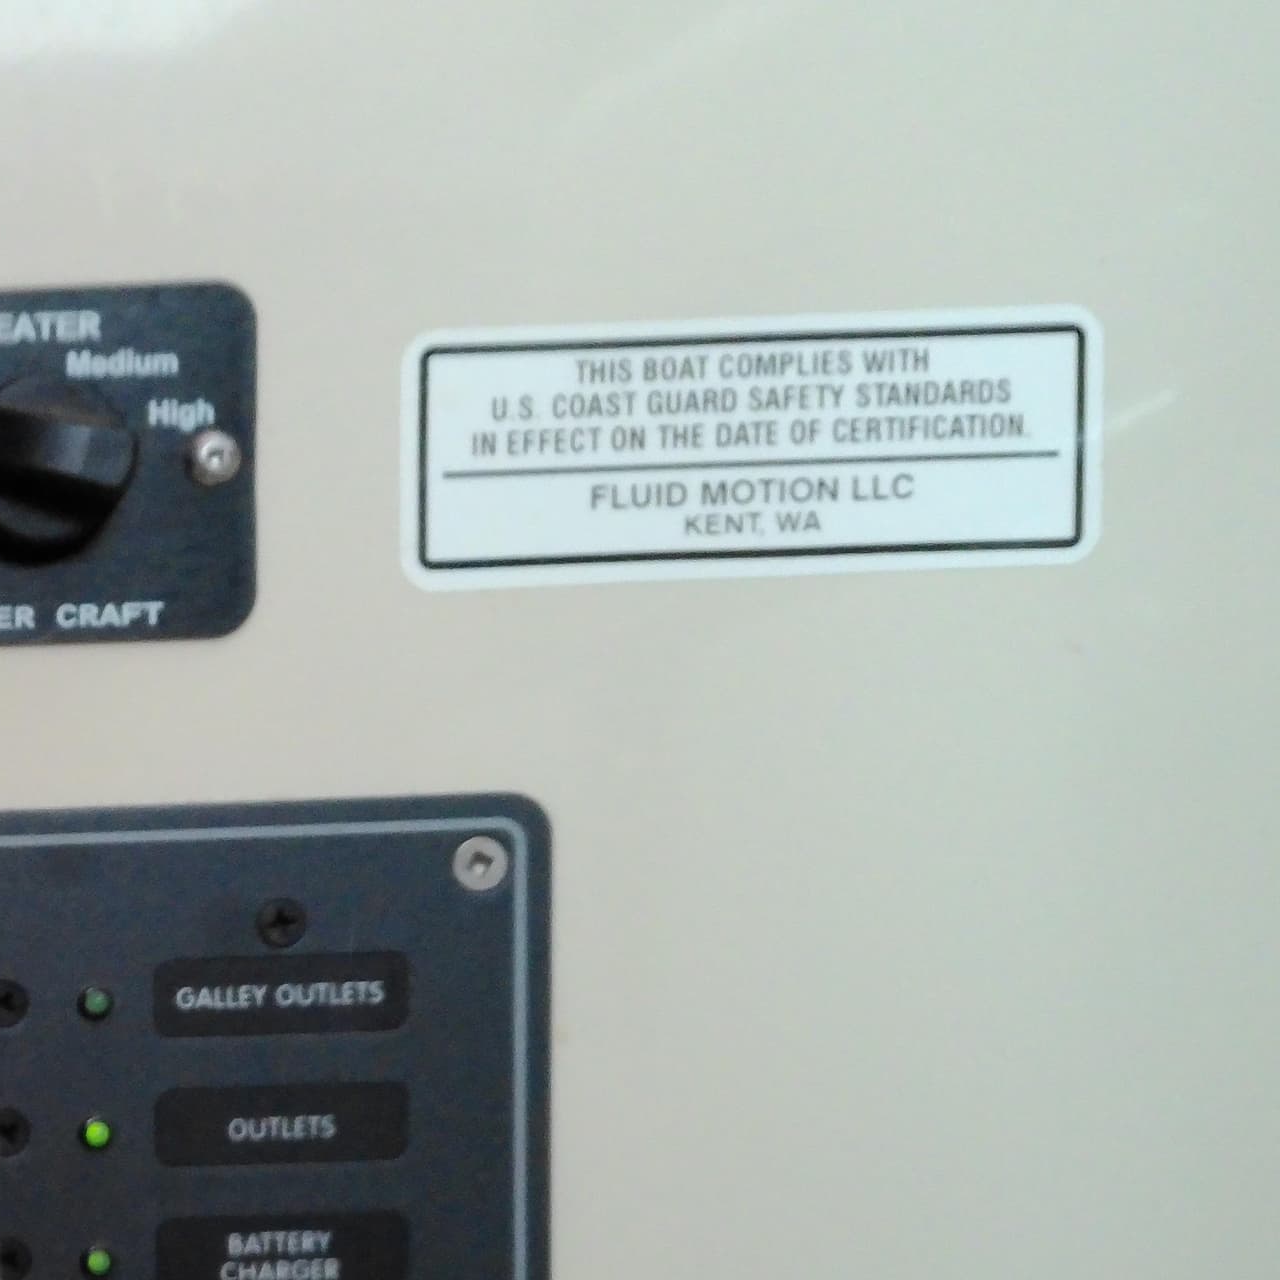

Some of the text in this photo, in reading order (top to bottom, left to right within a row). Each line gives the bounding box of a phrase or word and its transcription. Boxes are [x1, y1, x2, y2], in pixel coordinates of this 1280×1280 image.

[65, 348, 180, 379] Medium
[575, 346, 930, 384] THIS BOAT COMPLIES WITH
[551, 390, 636, 419] COAST
[646, 387, 738, 416] GUARD
[748, 382, 845, 413] SAFETY
[855, 377, 1013, 409] STANDARDS
[146, 398, 216, 433] High
[470, 430, 497, 457] IN
[506, 425, 603, 456] EFFECT
[609, 424, 647, 452] ON
[657, 421, 705, 450] THE
[714, 418, 780, 448] DATE
[789, 416, 822, 445] OF
[589, 472, 915, 511] FLUID MOTION LLC
[775, 510, 822, 533] WA
[55, 600, 166, 629] CRAFT
[175, 980, 386, 1010] GALLEY OUTLETS
[228, 1114, 338, 1142] OUTLETS
[227, 1229, 332, 1256] BATTERY
